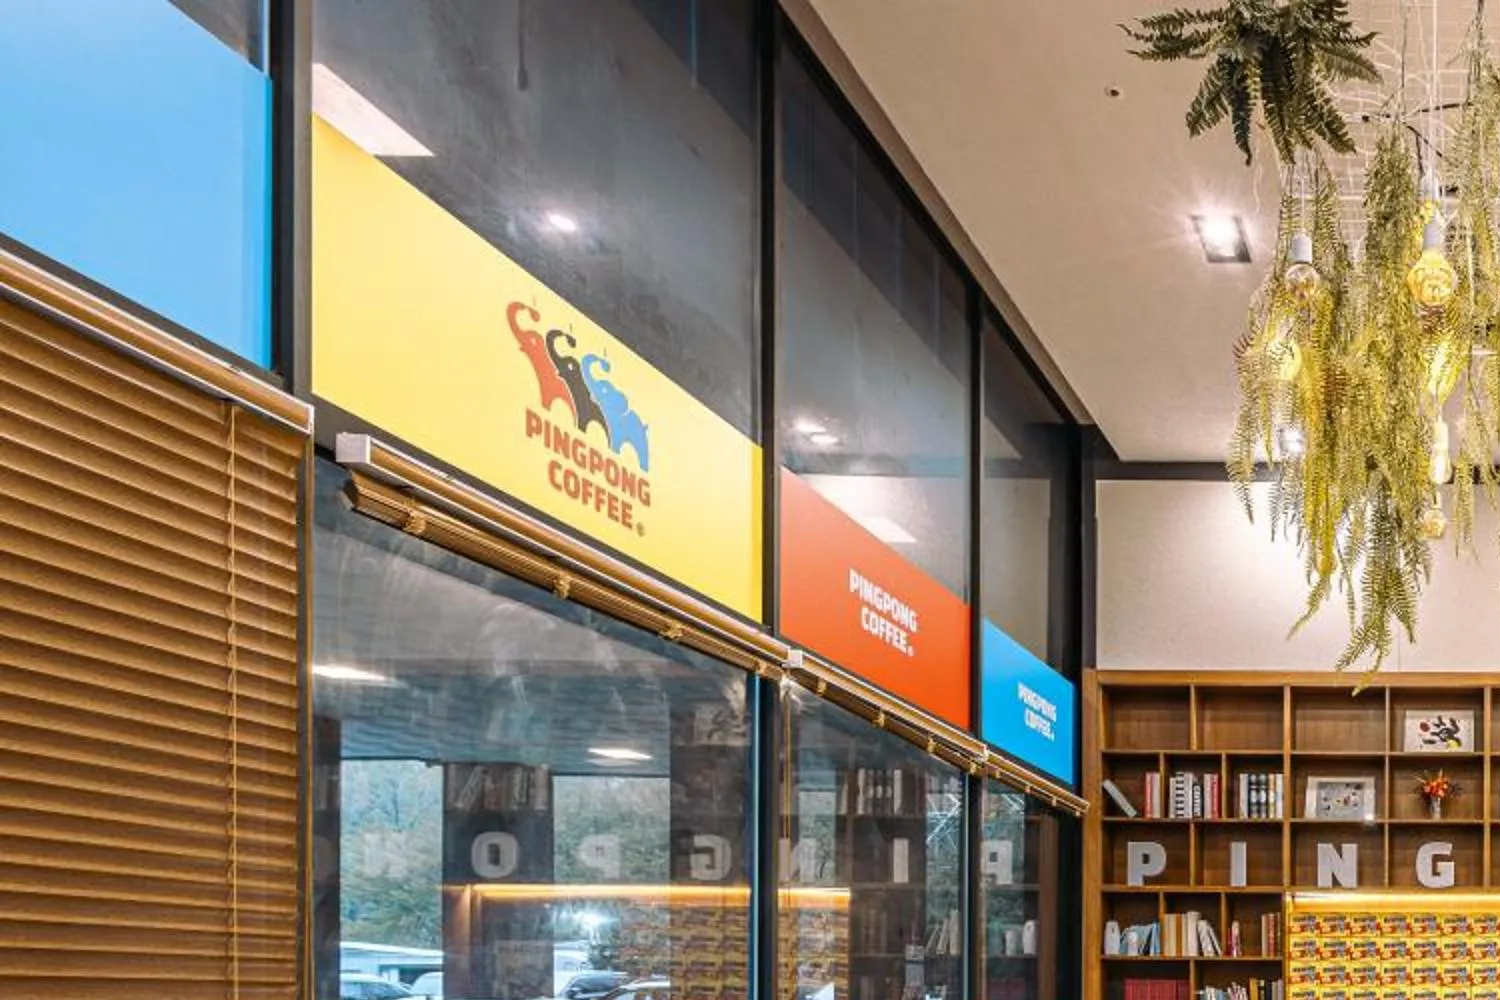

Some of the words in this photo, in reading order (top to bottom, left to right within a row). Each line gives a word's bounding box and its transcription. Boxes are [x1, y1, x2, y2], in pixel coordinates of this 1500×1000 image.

[525, 407, 650, 507] PINGPONG
[548, 459, 633, 530] COFFEE
[849, 567, 917, 633] PINGPONG
[861, 606, 908, 656] COFFEE
[1018, 682, 1057, 722] PINGPONG
[1024, 707, 1051, 739] COFFEE
